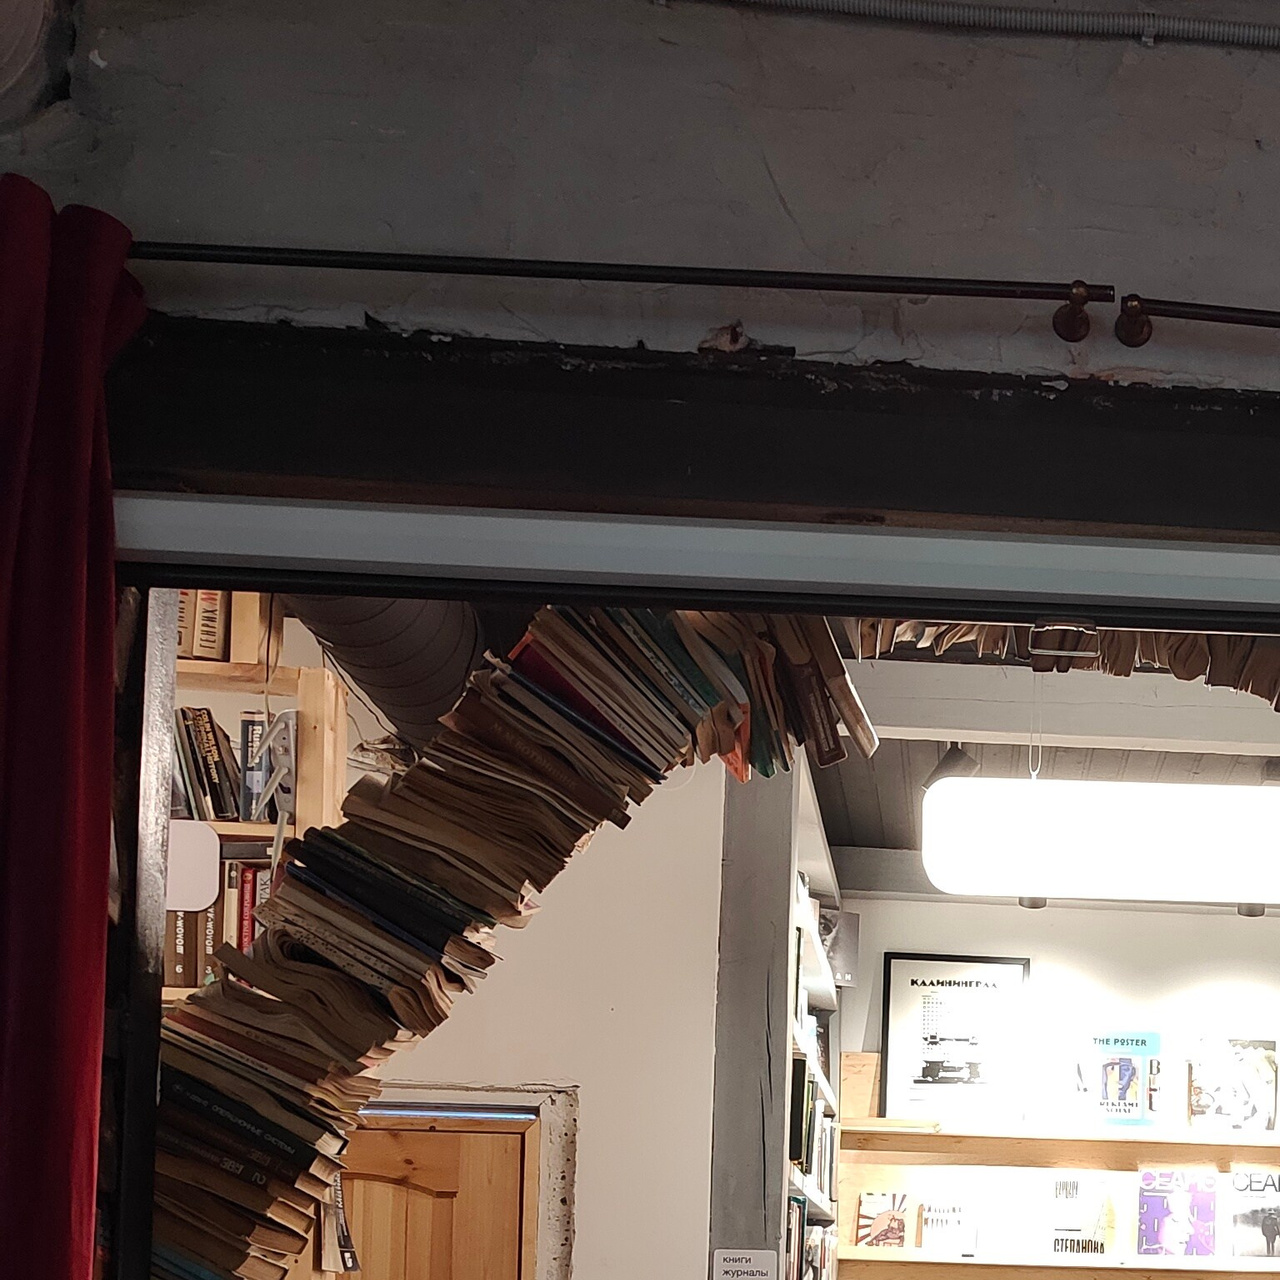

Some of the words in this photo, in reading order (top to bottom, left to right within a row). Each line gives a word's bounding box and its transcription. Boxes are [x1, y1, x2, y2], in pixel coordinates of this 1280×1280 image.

[199, 607, 218, 650] ГЕНРИХ
[207, 755, 220, 783] HISTORY
[175, 911, 185, 955] ШОЛОМ-А
[834, 971, 852, 981] АН
[1092, 1037, 1111, 1046] THE
[1113, 1037, 1147, 1047] POSTER
[722, 1256, 752, 1264] книги
[722, 1268, 769, 1278] журналы
